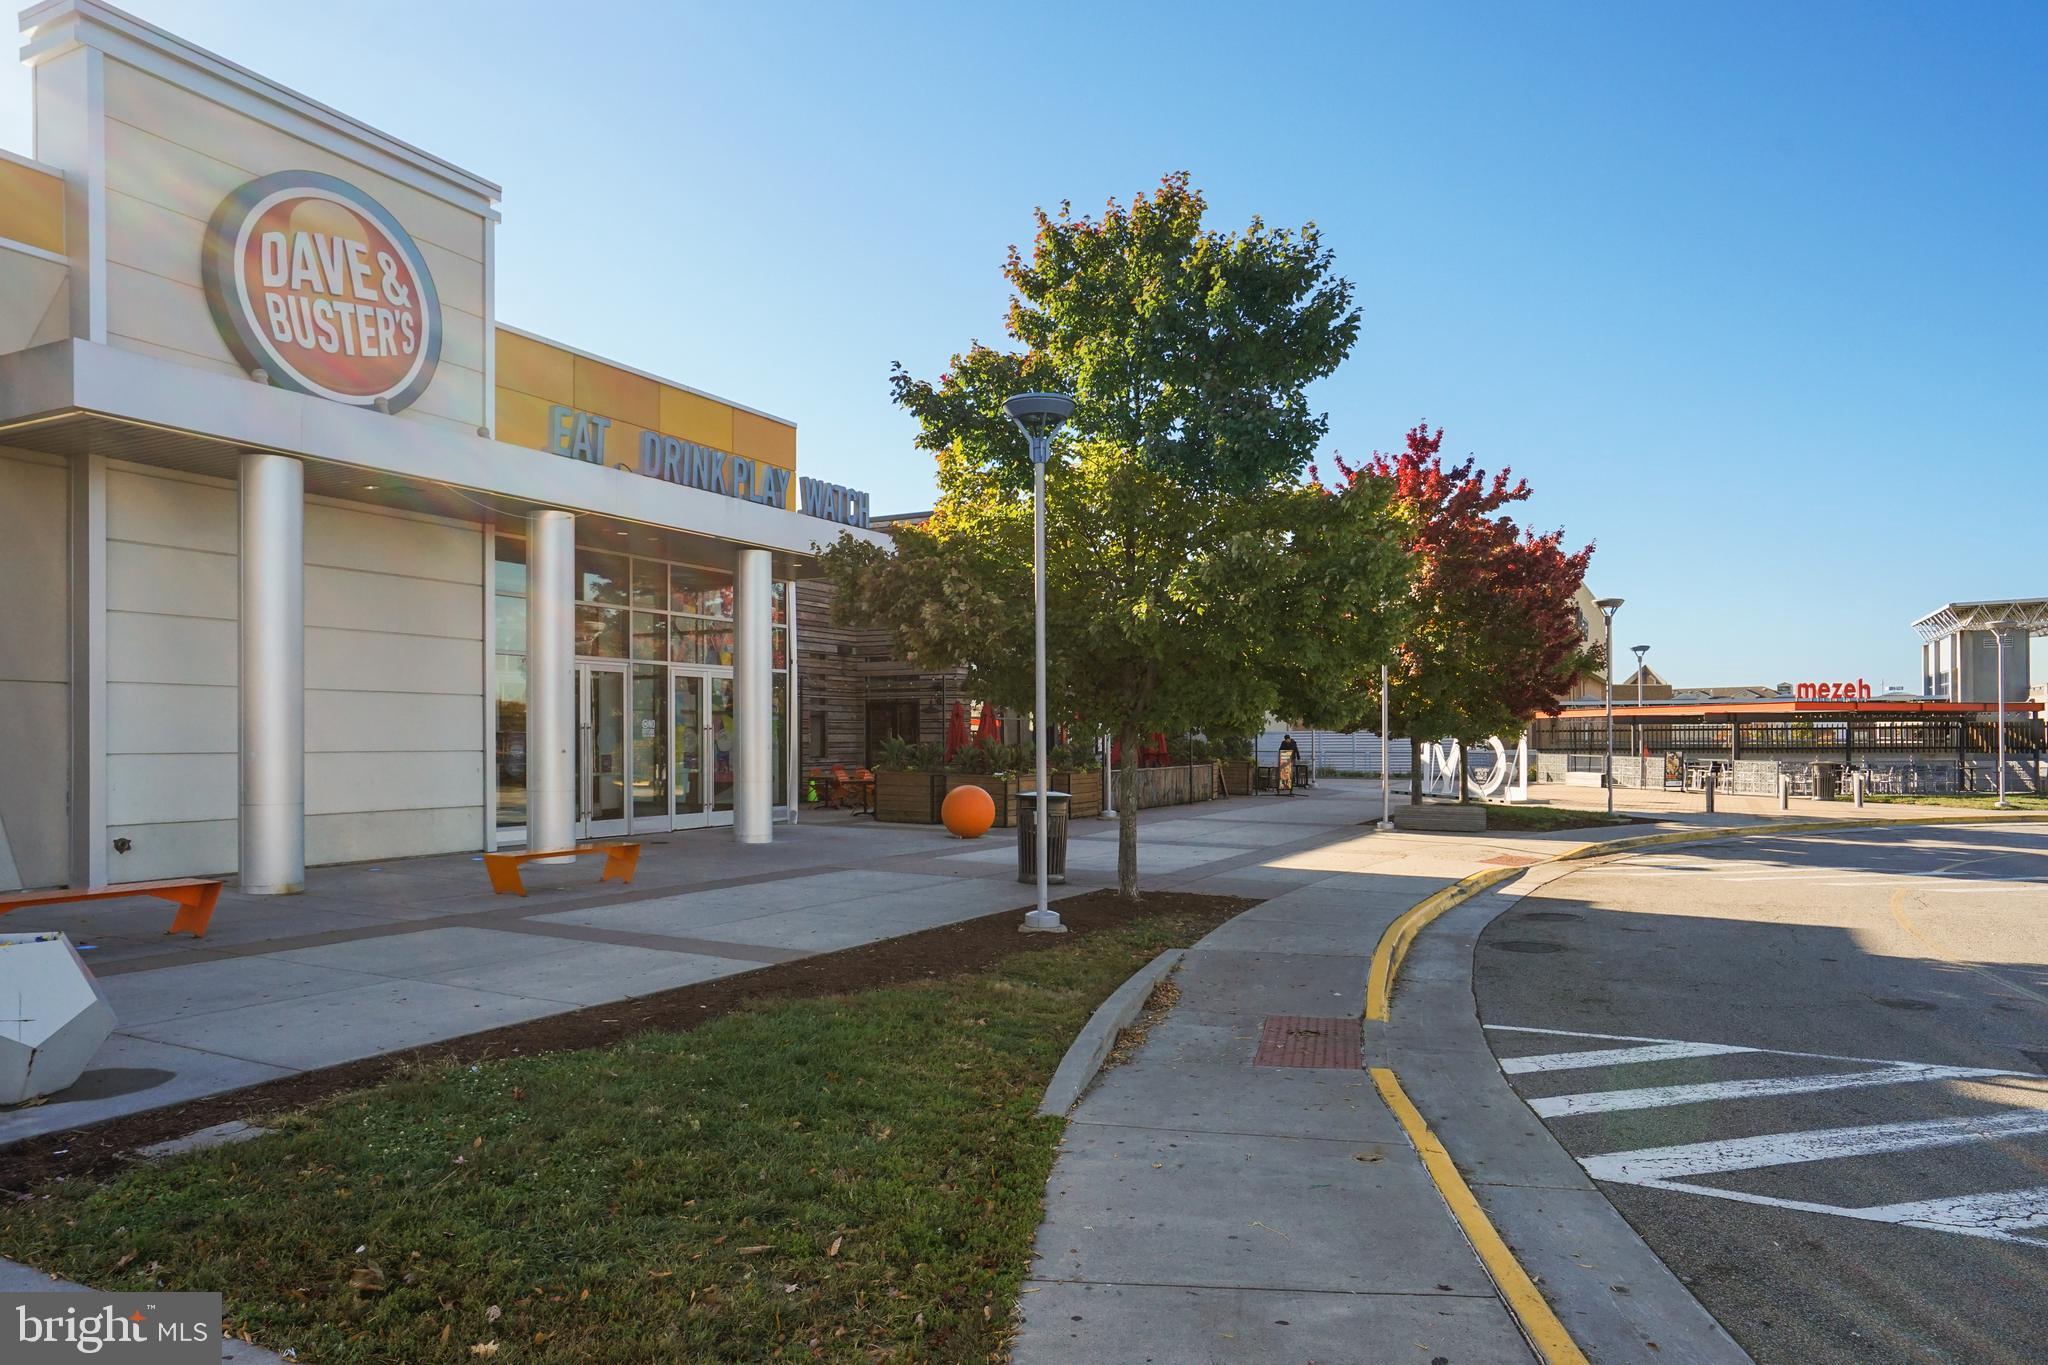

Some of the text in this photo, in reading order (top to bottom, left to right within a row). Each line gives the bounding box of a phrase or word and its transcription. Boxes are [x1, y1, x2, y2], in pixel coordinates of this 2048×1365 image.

[261, 231, 412, 308] DAVE &
[265, 292, 415, 357] BUSTER'S
[549, 405, 870, 529] EAT DRINK PLAY WATCH
[1797, 678, 1871, 699] mezeh
